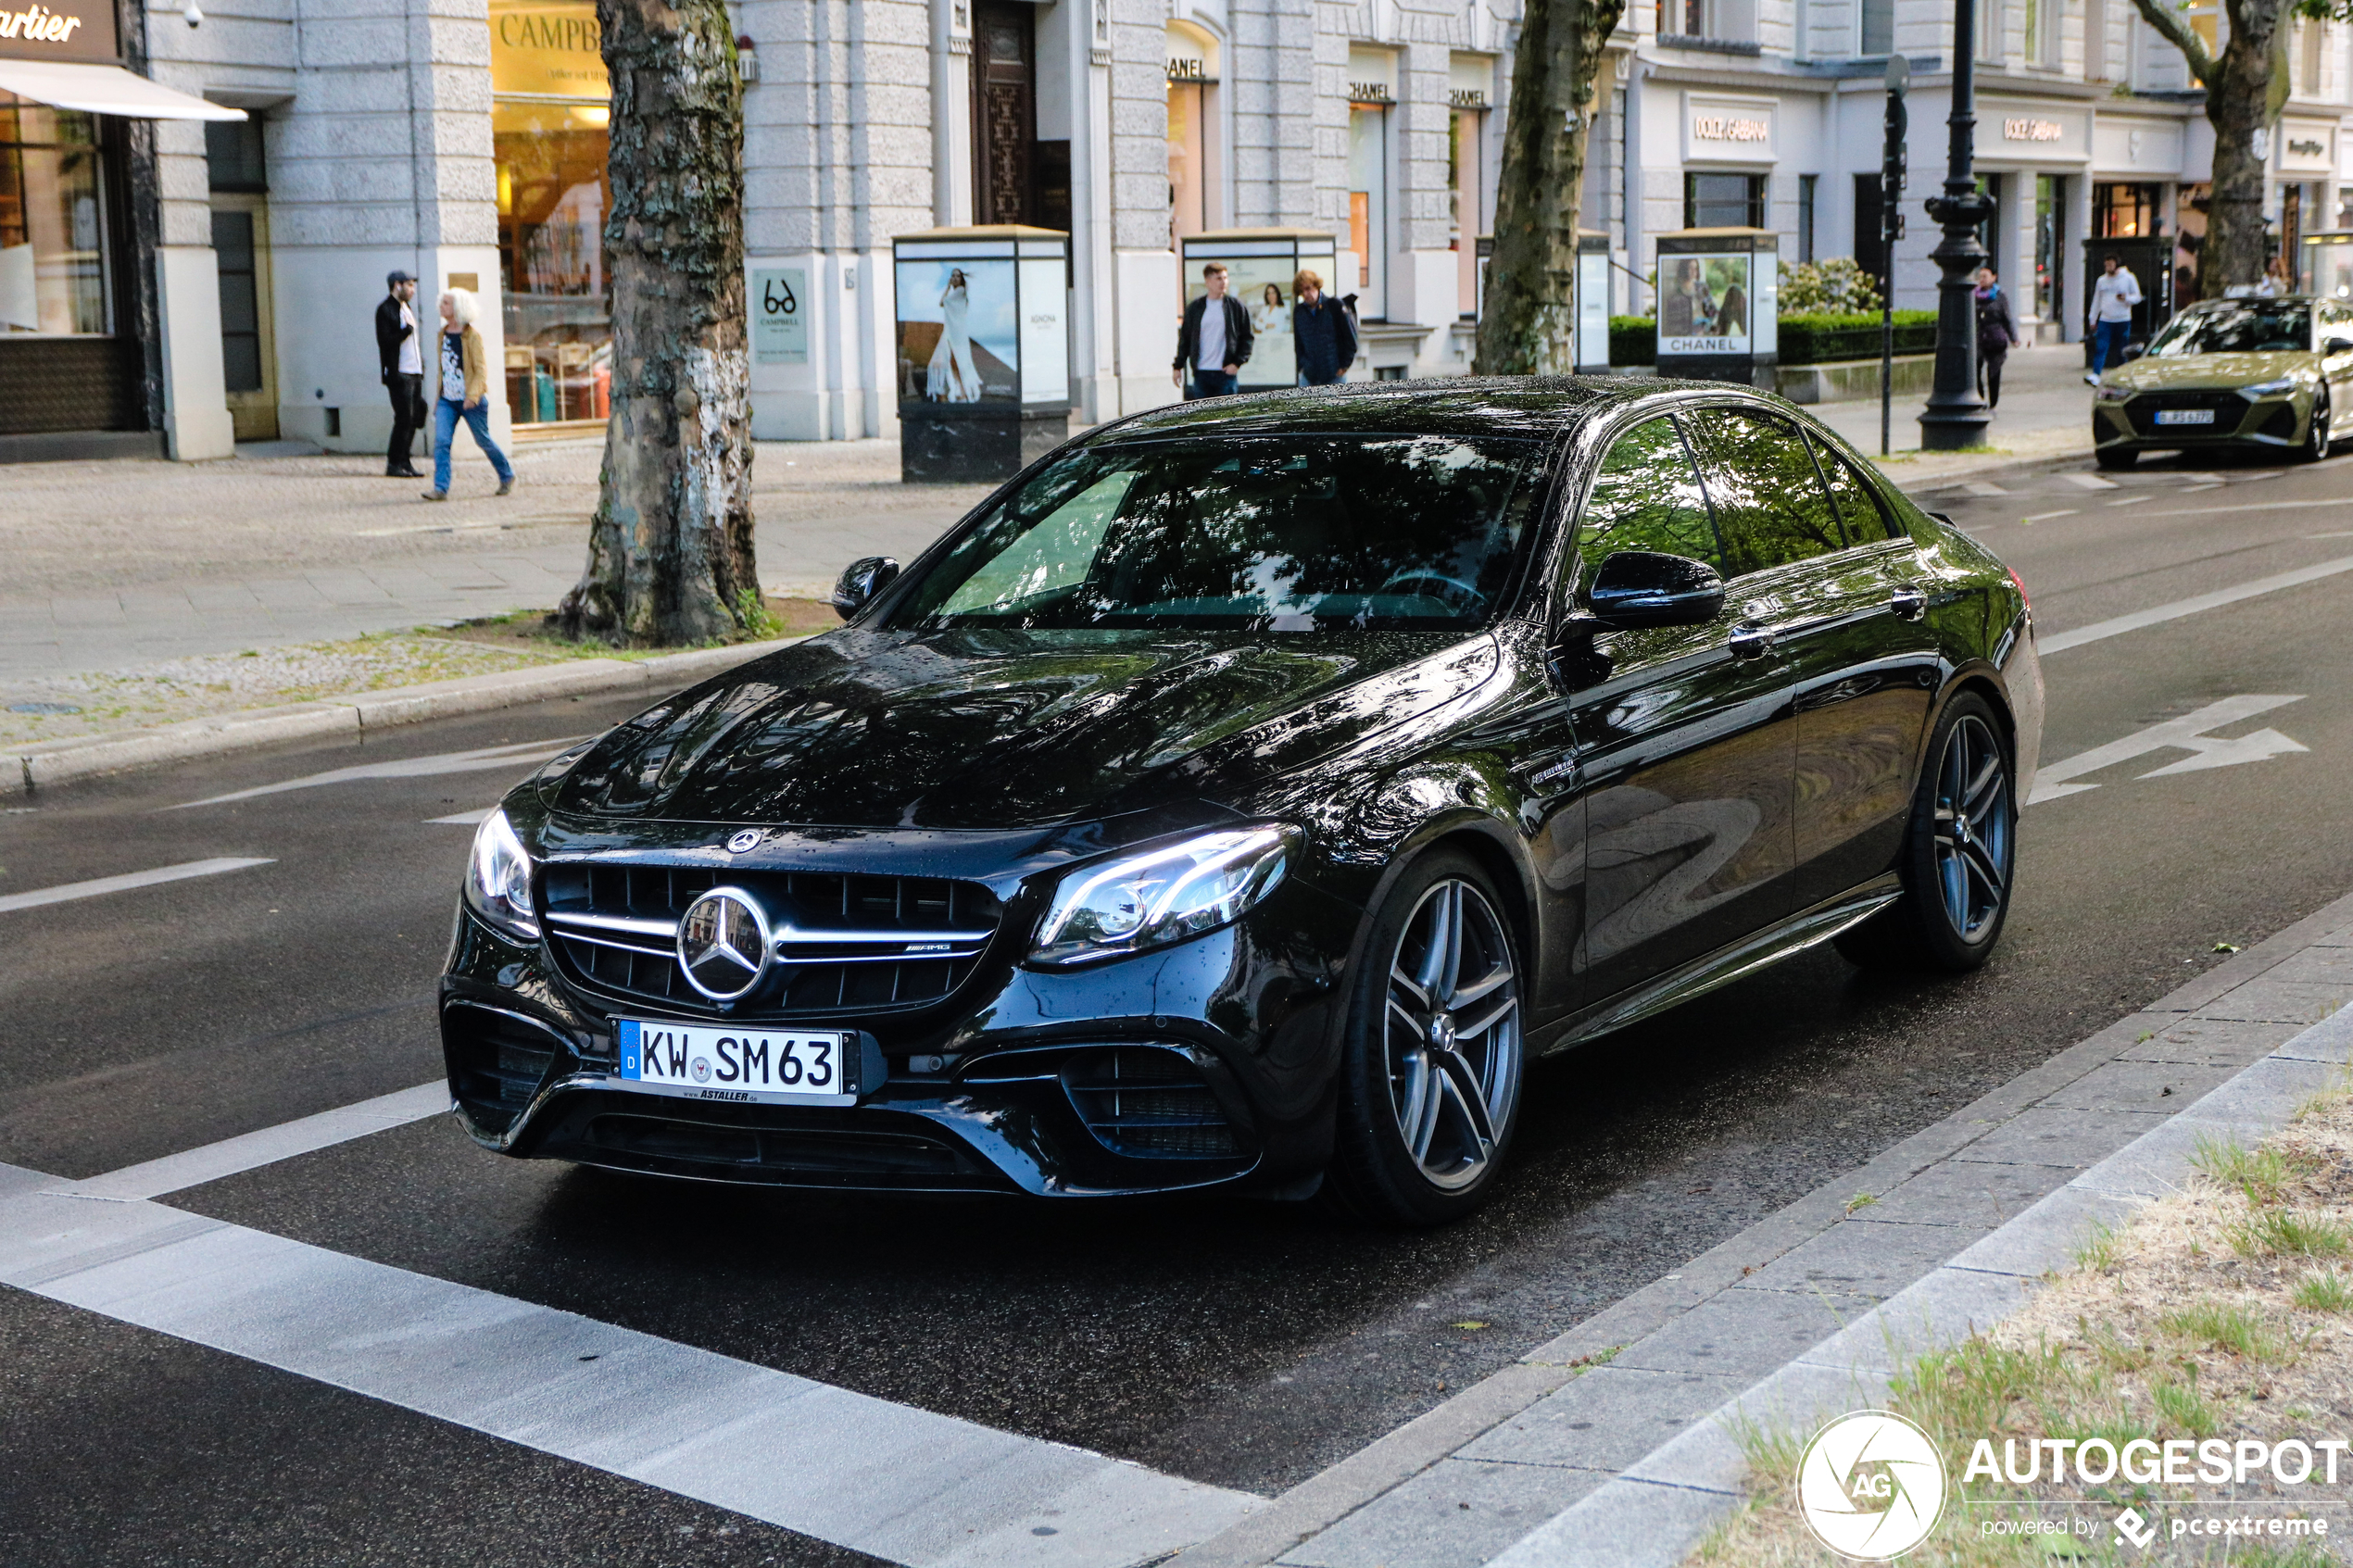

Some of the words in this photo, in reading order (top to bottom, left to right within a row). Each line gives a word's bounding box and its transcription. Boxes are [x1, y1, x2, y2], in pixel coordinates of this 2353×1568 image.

[0, 3, 82, 42] artier
[499, 13, 601, 53] CAMPB
[760, 318, 798, 326] CAMPBELL
[1670, 339, 1737, 351] CHANEL
[627, 1056, 635, 1069] D
[643, 1030, 688, 1078] KW
